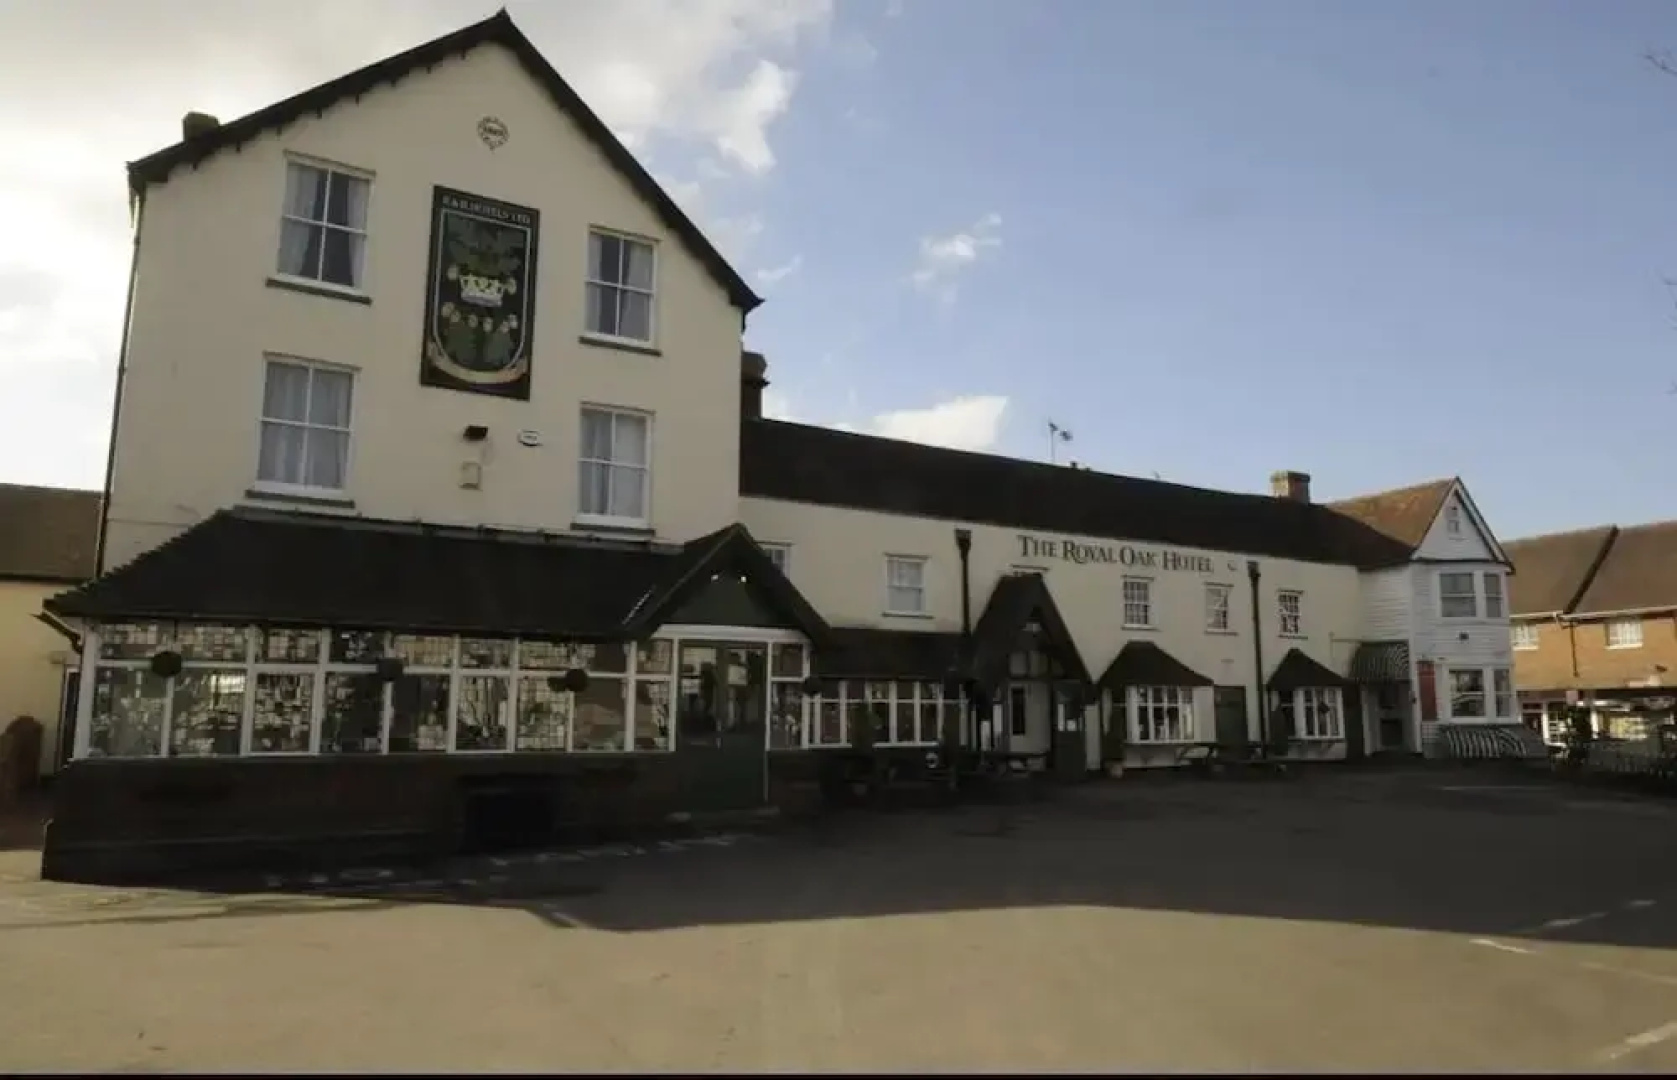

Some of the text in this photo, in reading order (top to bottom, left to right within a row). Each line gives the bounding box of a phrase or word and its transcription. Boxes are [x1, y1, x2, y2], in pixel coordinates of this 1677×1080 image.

[1016, 534, 1057, 558] THE
[1062, 539, 1118, 564] ROYAL
[1119, 546, 1156, 566] OAK
[1162, 549, 1214, 573] HOTEL
